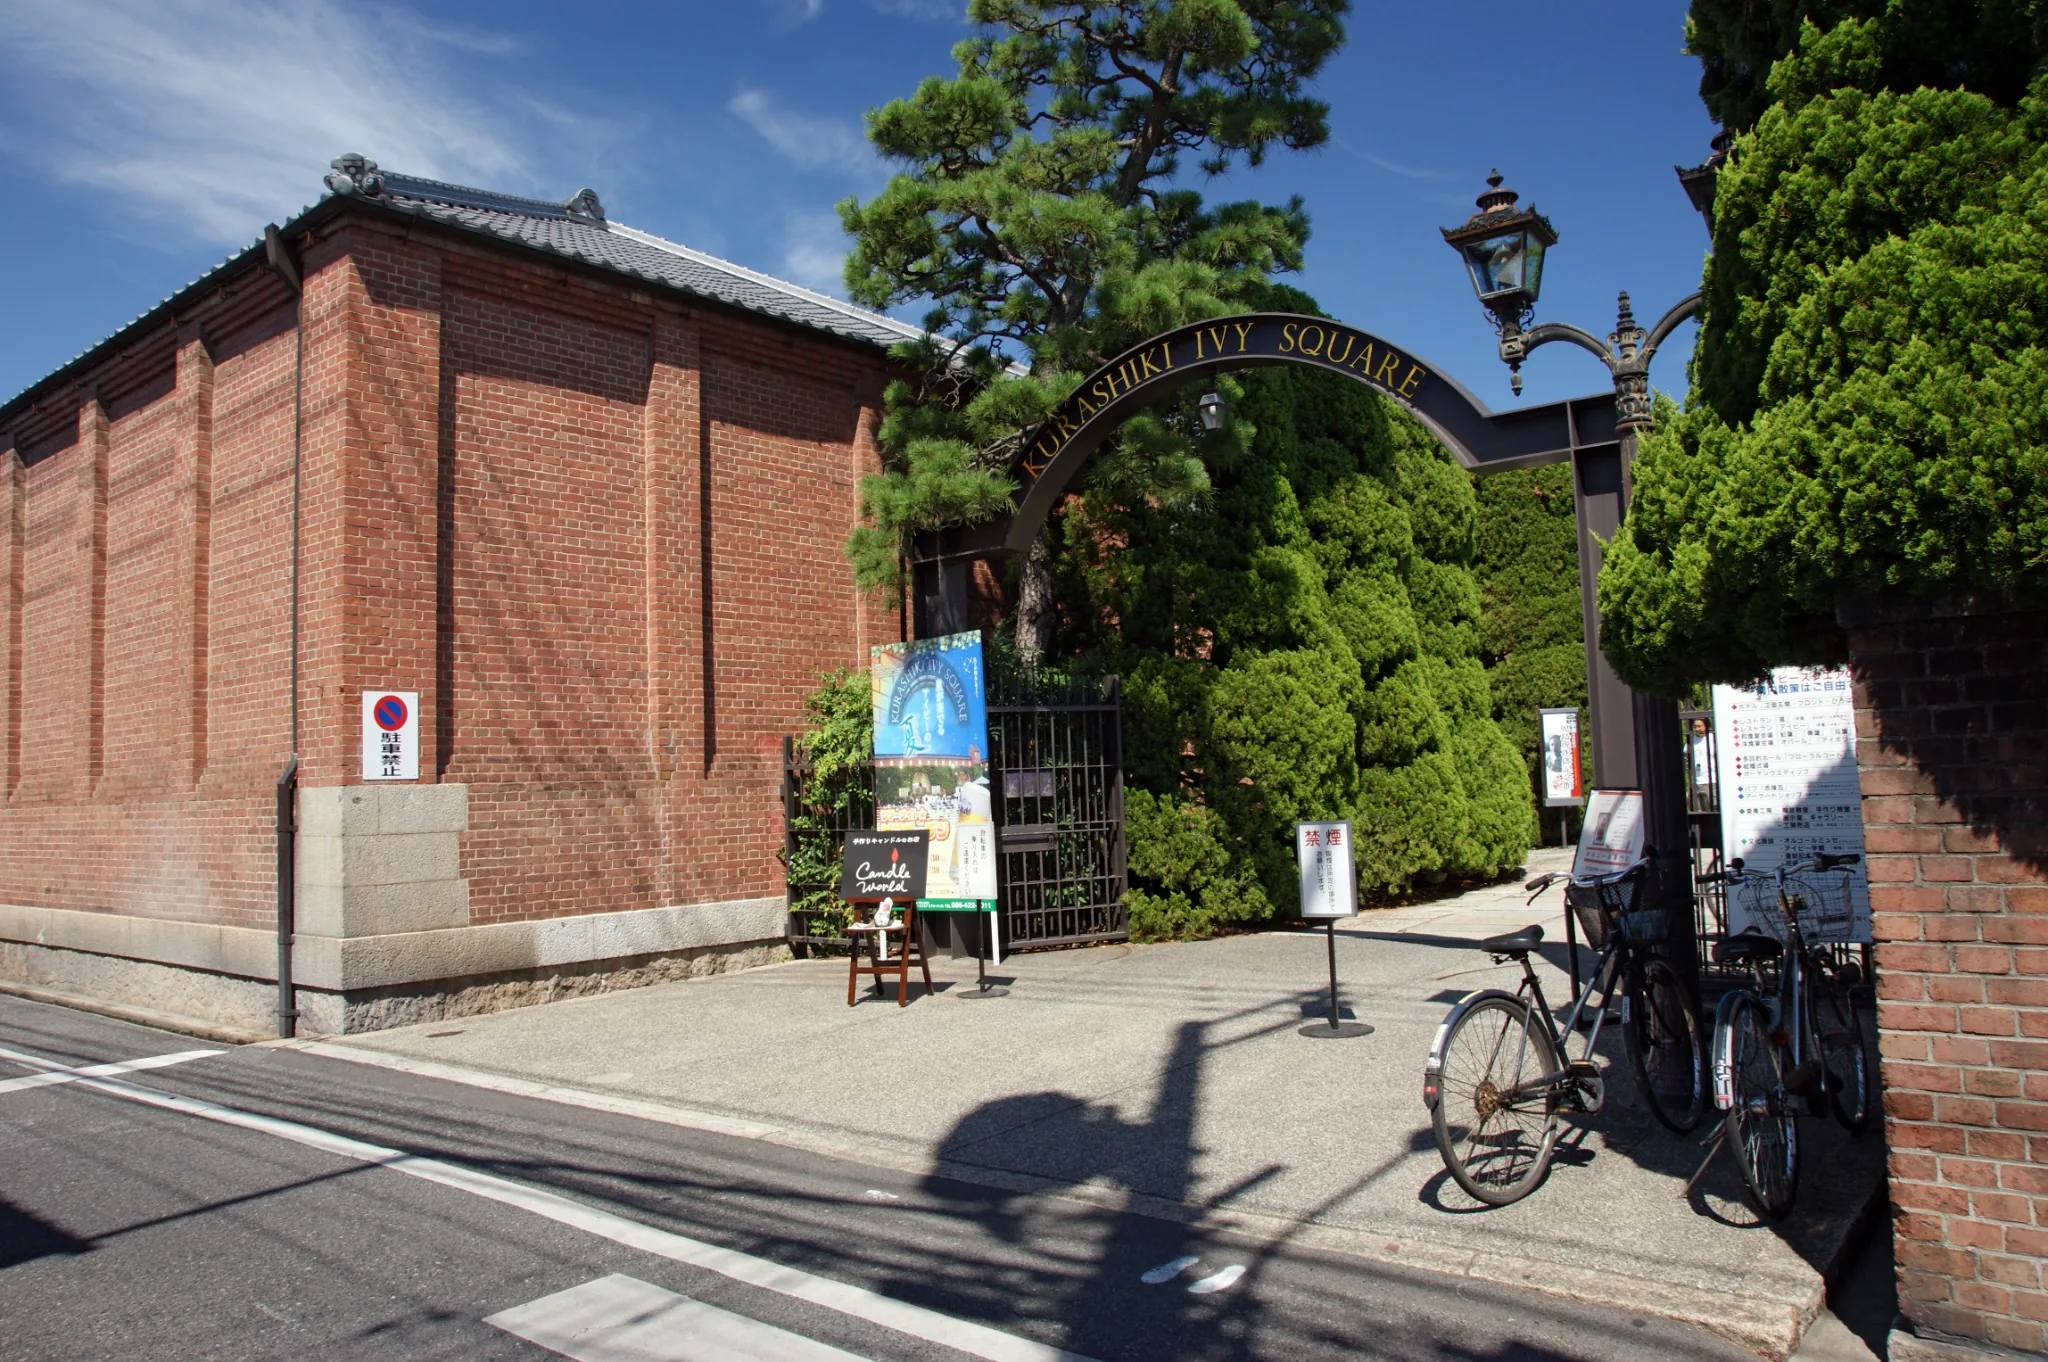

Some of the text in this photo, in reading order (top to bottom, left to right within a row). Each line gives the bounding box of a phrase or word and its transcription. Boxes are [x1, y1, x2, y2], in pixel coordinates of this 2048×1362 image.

[1021, 322, 1427, 480] KURASHIKI IVY SQUARE
[891, 659, 925, 723] KURASHIKI
[928, 659, 944, 673] IVY
[944, 669, 968, 721] SQUARE
[381, 732, 401, 776] 駐車禁止
[1304, 828, 1342, 846] 禁煙
[855, 861, 911, 881] Candle
